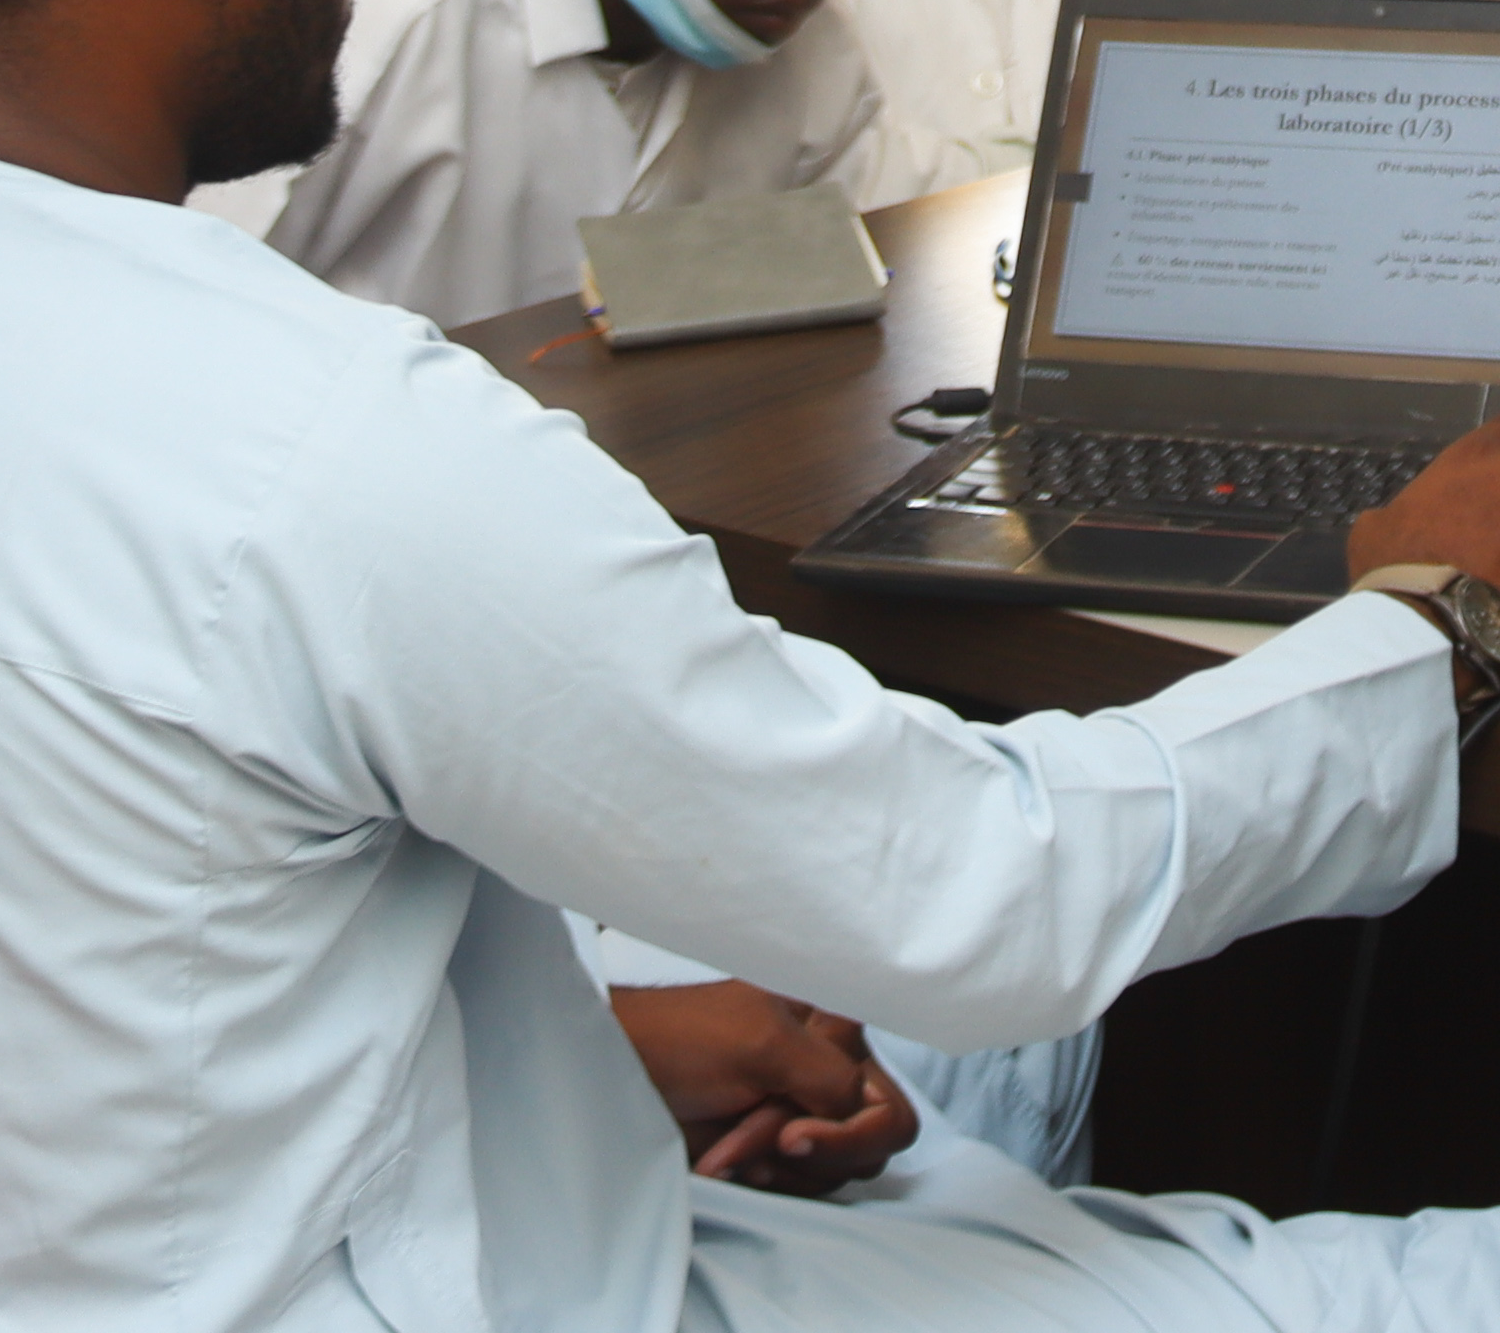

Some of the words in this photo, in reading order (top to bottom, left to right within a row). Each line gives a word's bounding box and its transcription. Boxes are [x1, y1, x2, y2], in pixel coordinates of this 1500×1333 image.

[1206, 78, 1246, 101] Les
[1252, 82, 1300, 103] trois
[1303, 83, 1378, 108] phases
[1383, 86, 1412, 106] du
[1277, 111, 1394, 136] laboratoire
[1399, 117, 1454, 143] (1/3)
